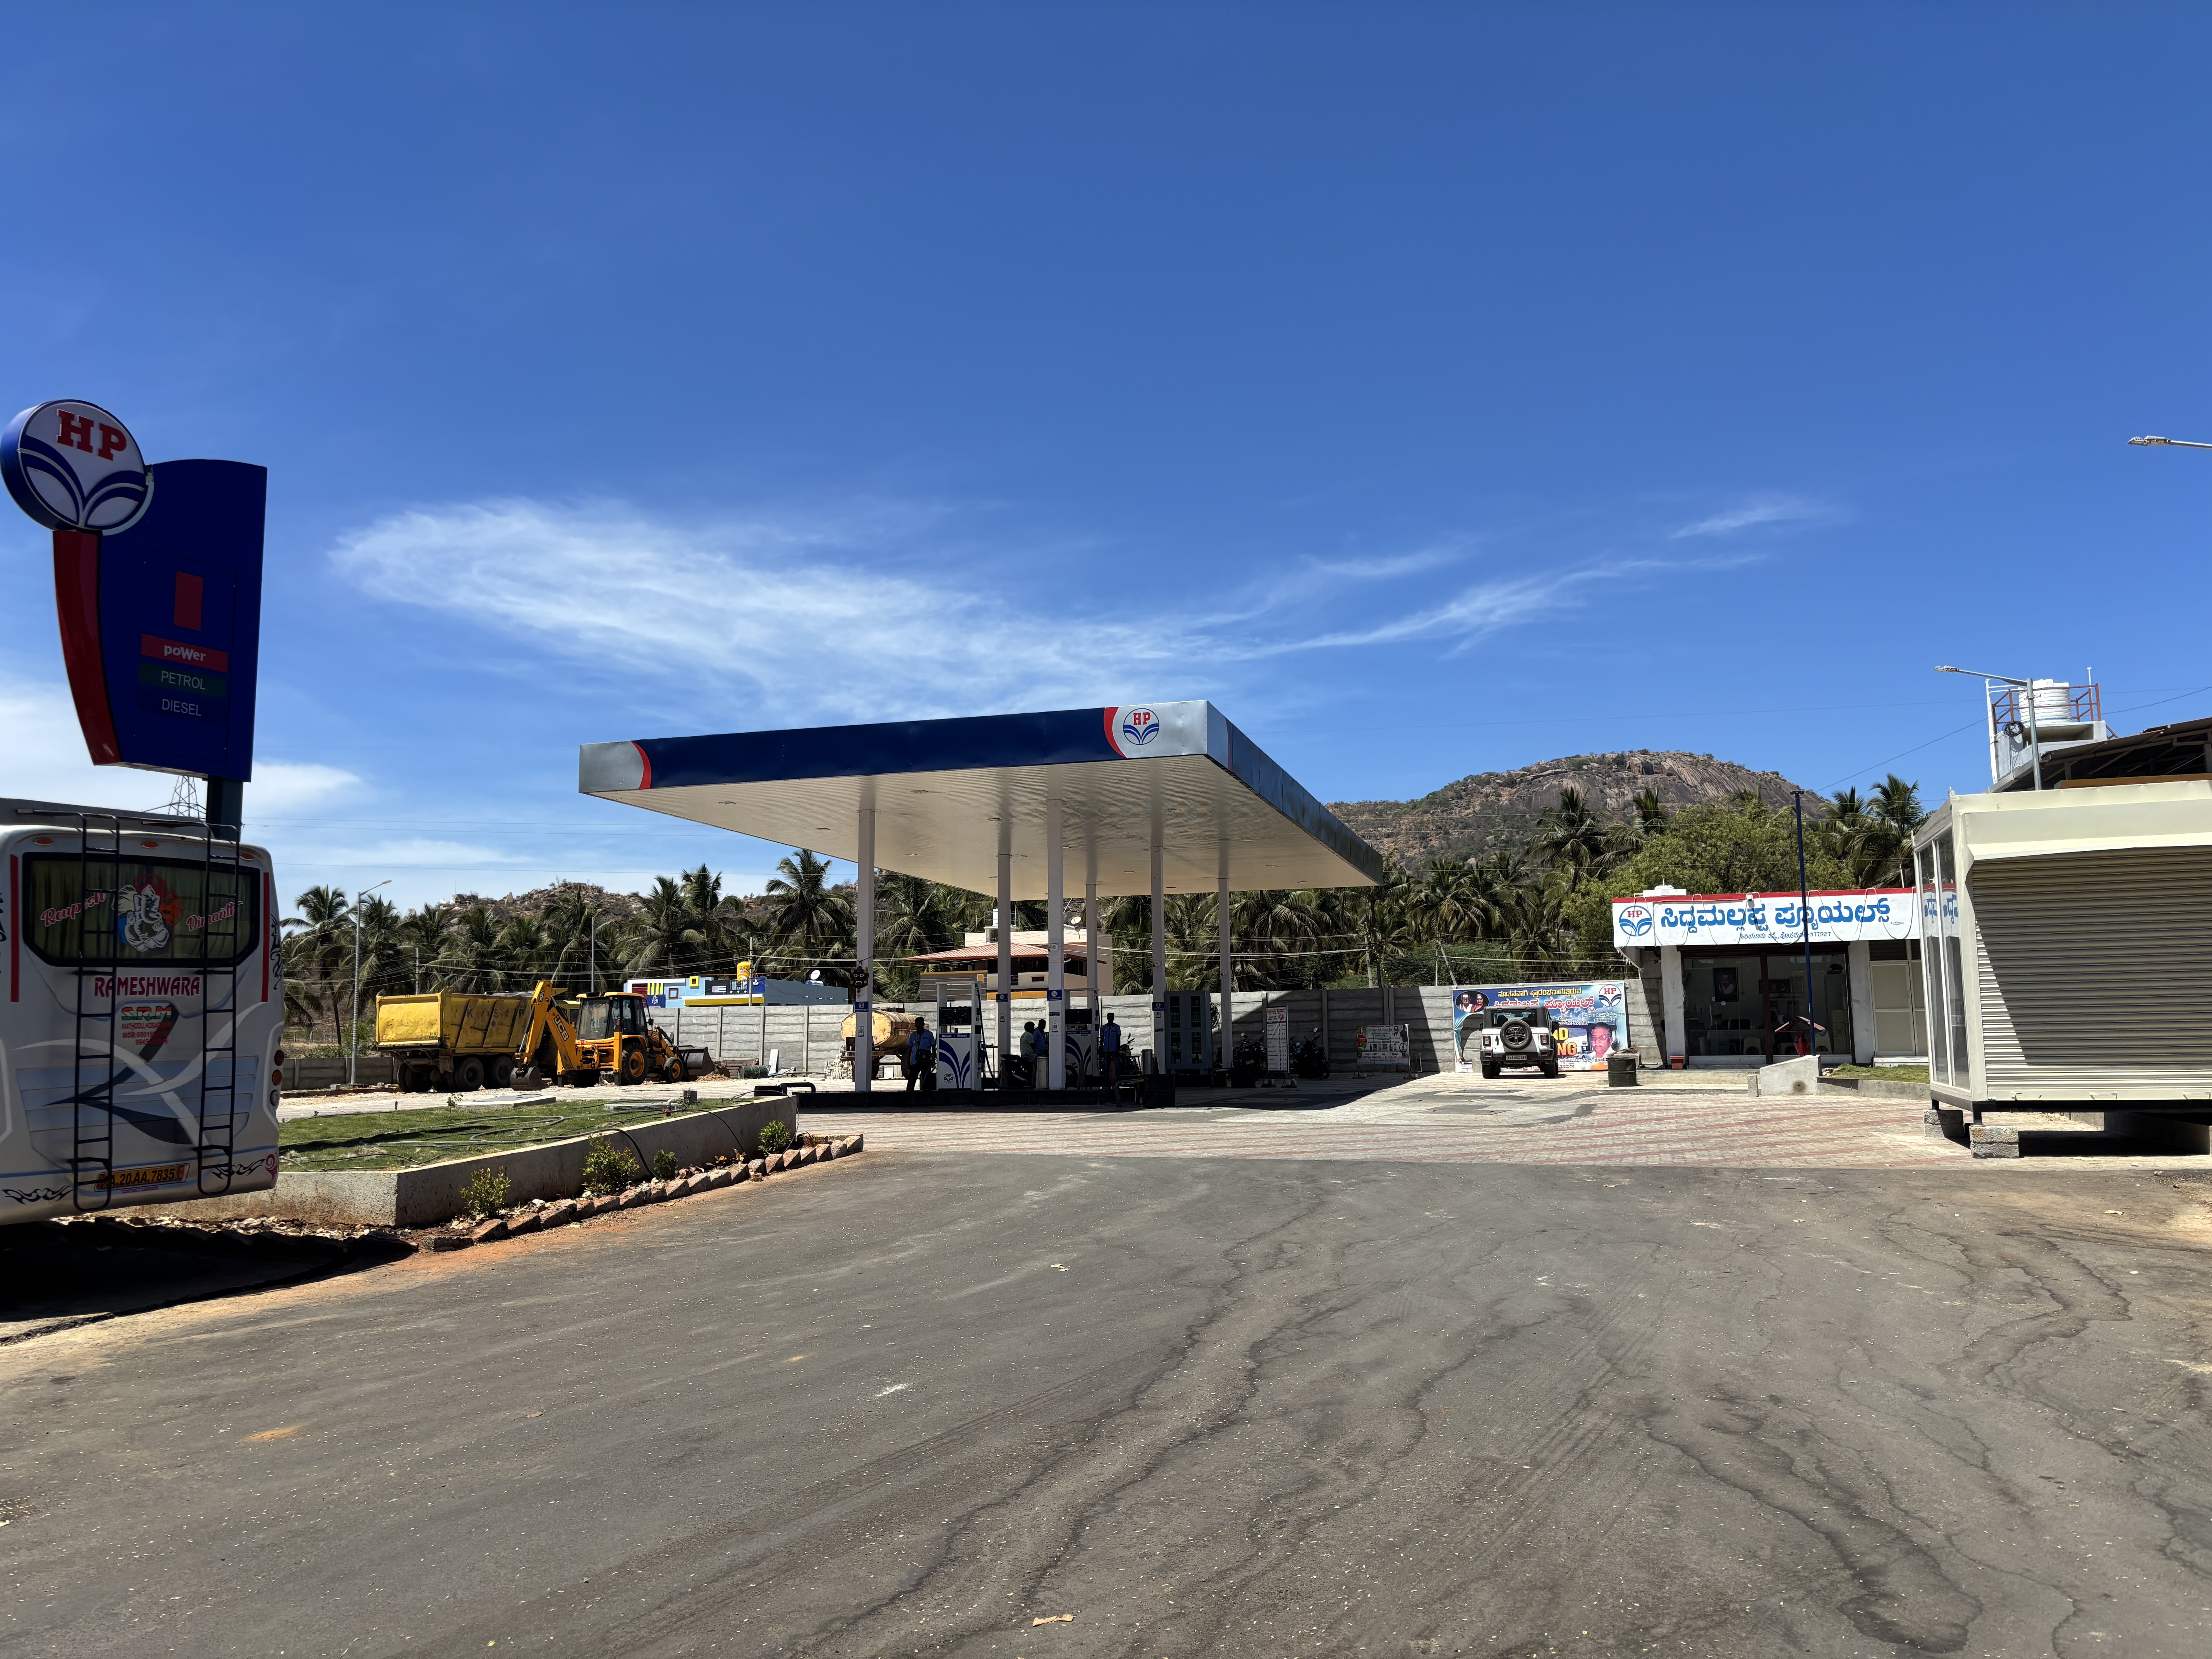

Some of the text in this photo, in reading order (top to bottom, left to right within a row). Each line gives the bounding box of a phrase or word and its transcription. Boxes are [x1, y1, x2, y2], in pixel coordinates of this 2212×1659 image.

[57, 409, 127, 461] HP
[161, 671, 206, 690] PETROL
[162, 699, 201, 716] DIESEL
[1133, 712, 1151, 725] HP
[94, 977, 200, 998] RAMESHWARA
[554, 1014, 569, 1041] JCB
[105, 1168, 176, 1187] A.20.AA.7835
